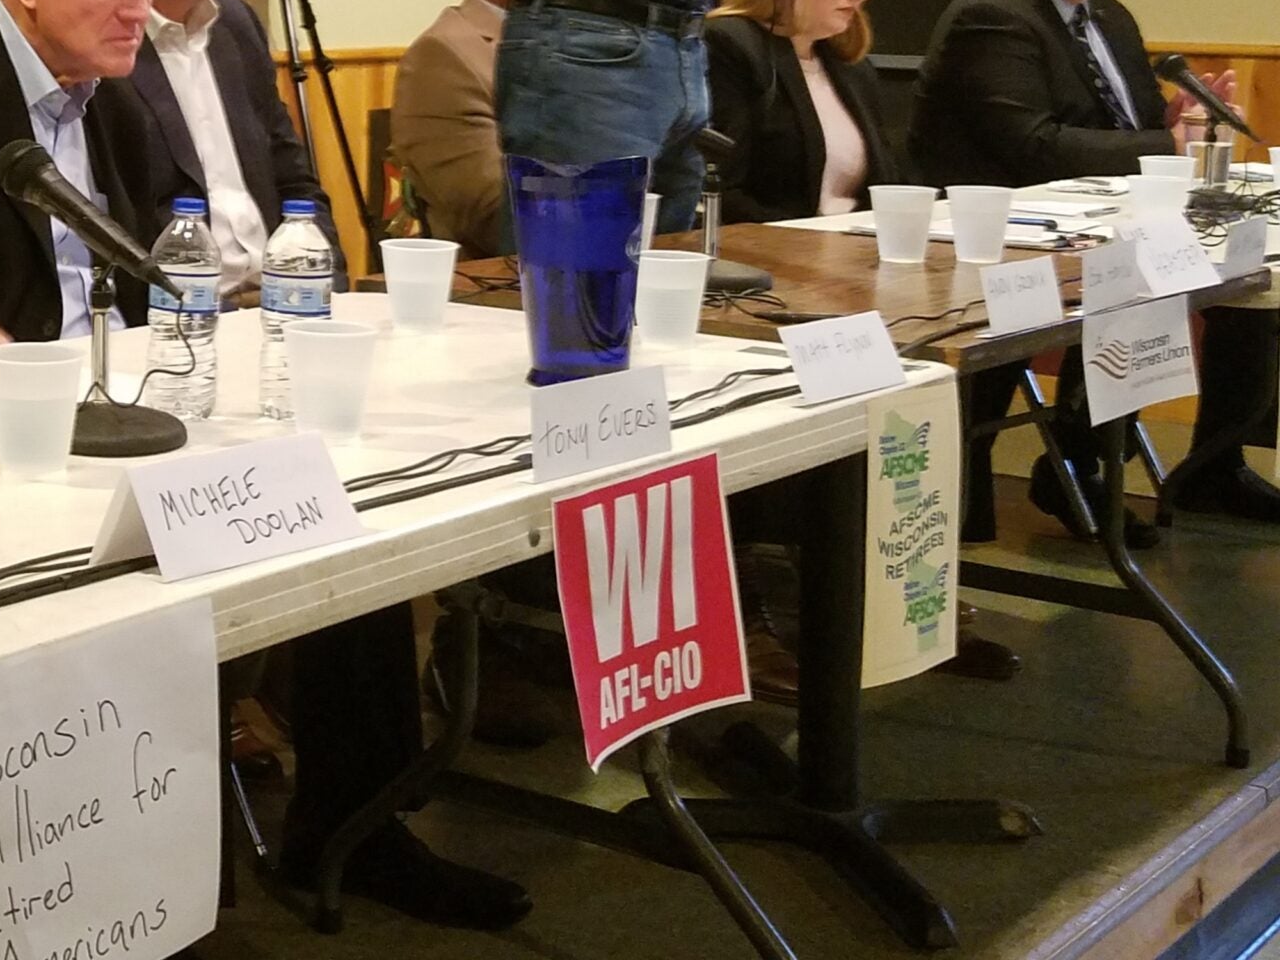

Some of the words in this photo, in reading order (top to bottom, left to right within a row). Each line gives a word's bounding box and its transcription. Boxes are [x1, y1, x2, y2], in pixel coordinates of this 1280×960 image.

[1131, 333, 1170, 355] Wisconsin
[1131, 351, 1161, 372] Farmers
[1163, 345, 1190, 362] Union
[538, 421, 590, 461] TONY
[598, 403, 657, 442] EVERS
[158, 466, 262, 531] MICHELE
[227, 495, 323, 547] DOOLAN
[890, 489, 941, 537] AFSCME
[877, 510, 948, 558] WISCONSIN
[885, 531, 945, 580] RETIREES
[582, 475, 698, 664] WI
[599, 641, 703, 730] AFL-CIO
[132, 731, 177, 814] for
